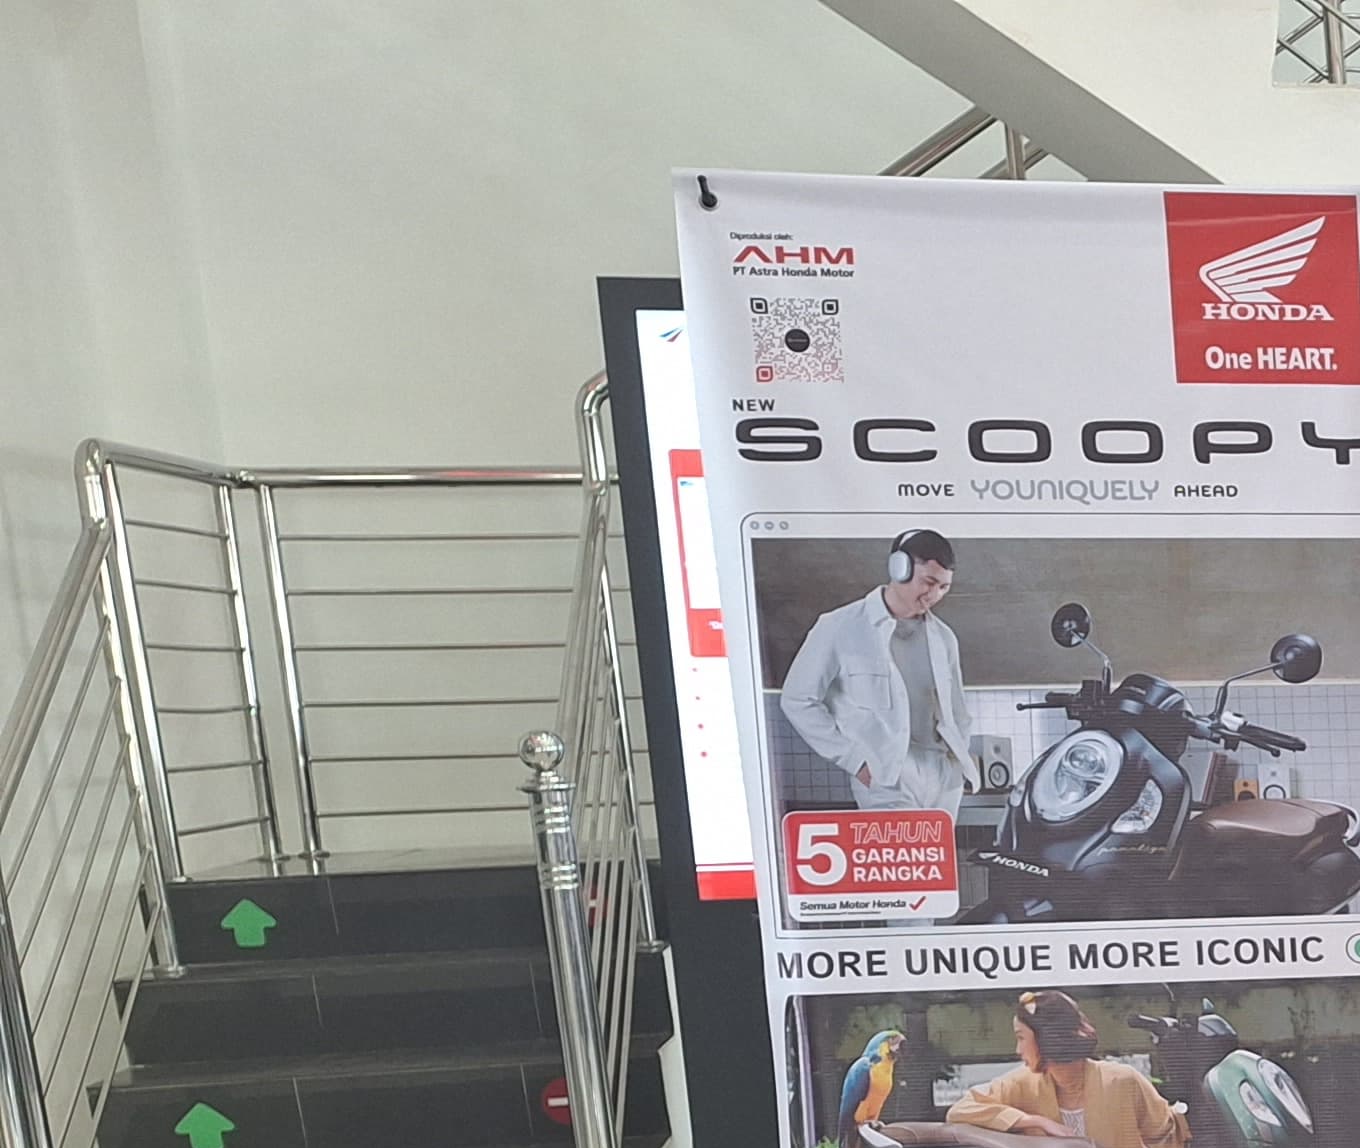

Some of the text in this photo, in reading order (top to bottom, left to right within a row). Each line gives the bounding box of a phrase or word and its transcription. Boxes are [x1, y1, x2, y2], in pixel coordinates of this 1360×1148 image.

[733, 245, 854, 264] AHM
[733, 267, 854, 277] PT Astra Honda Motor
[1202, 303, 1335, 321] HONDA
[1205, 346, 1338, 371] One HEART.
[732, 399, 776, 412] NEW
[898, 480, 1238, 505] MOVE YOUNIQUELY AHEAD
[796, 821, 942, 886] 5 TAHUN
[852, 847, 945, 864] GARANSI
[853, 865, 943, 882] RANGKA
[993, 854, 1049, 877] HONDA
[800, 899, 906, 911] Semua Motor Honda
[777, 935, 1326, 980] MORE UNIQUE MORE ICONIC
